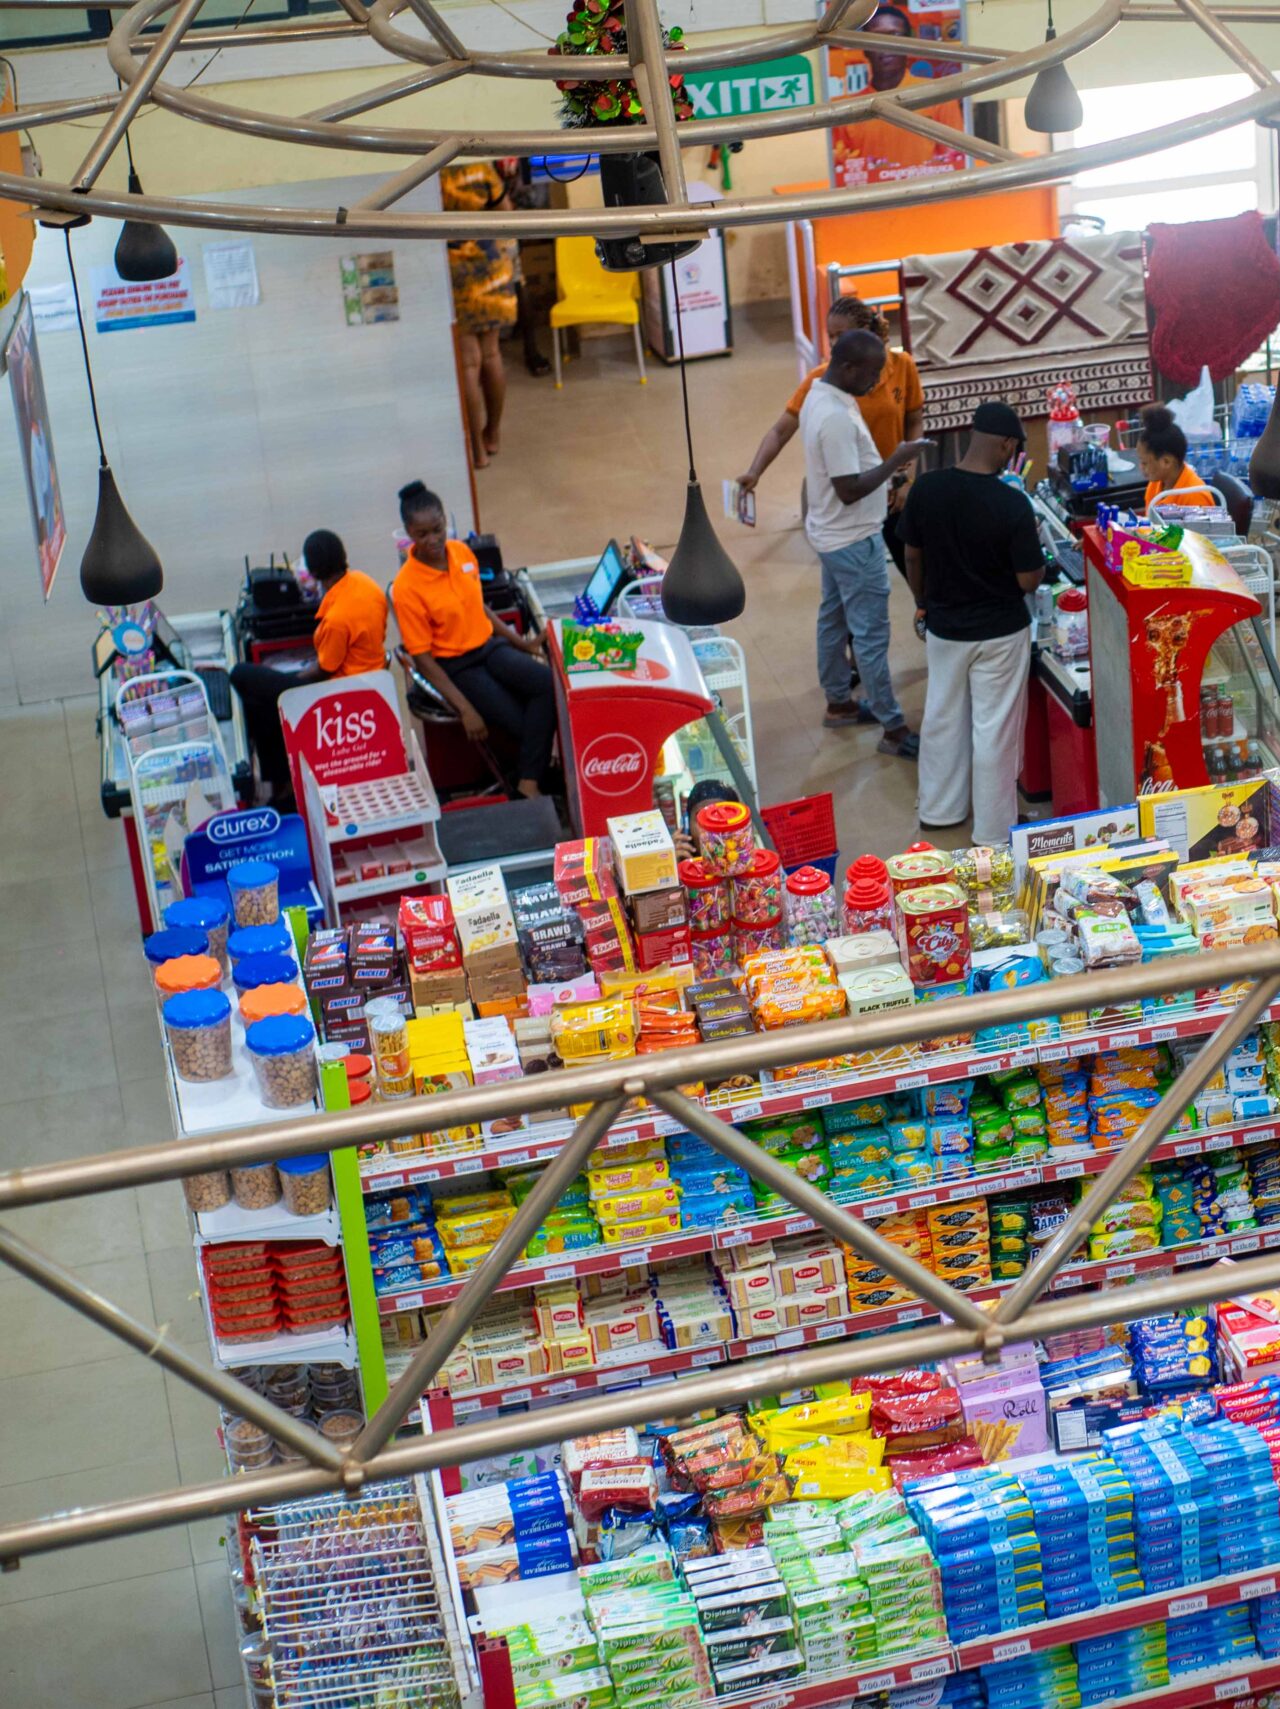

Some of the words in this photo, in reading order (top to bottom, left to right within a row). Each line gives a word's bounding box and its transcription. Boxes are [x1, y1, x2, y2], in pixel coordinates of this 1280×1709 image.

[685, 78, 756, 116] XIT
[314, 701, 376, 750] kiss
[585, 751, 642, 777] Coca-Cola
[214, 813, 270, 838] durex
[1031, 833, 1073, 850] Moments
[532, 924, 571, 942] BRAWO
[354, 968, 389, 979] SNICKERS
[311, 976, 345, 989] SNICKERS
[328, 996, 361, 1010] SNICKERS
[859, 1004, 880, 1014] BLACK
[882, 998, 910, 1009] TRUFFLE
[1216, 1382, 1254, 1395] Colgate
[1225, 1393, 1264, 1407] Colgate
[1003, 1400, 1038, 1418] Roll
[1230, 1405, 1270, 1419] Colgate
[703, 1607, 740, 1620] Diplomat
[804, 1613, 834, 1627] Diplomat
[710, 1642, 748, 1654] Diplomat
[808, 1635, 838, 1647] Diplomat
[809, 1650, 840, 1662] Diplomat
[723, 1678, 760, 1692] Diplomat
